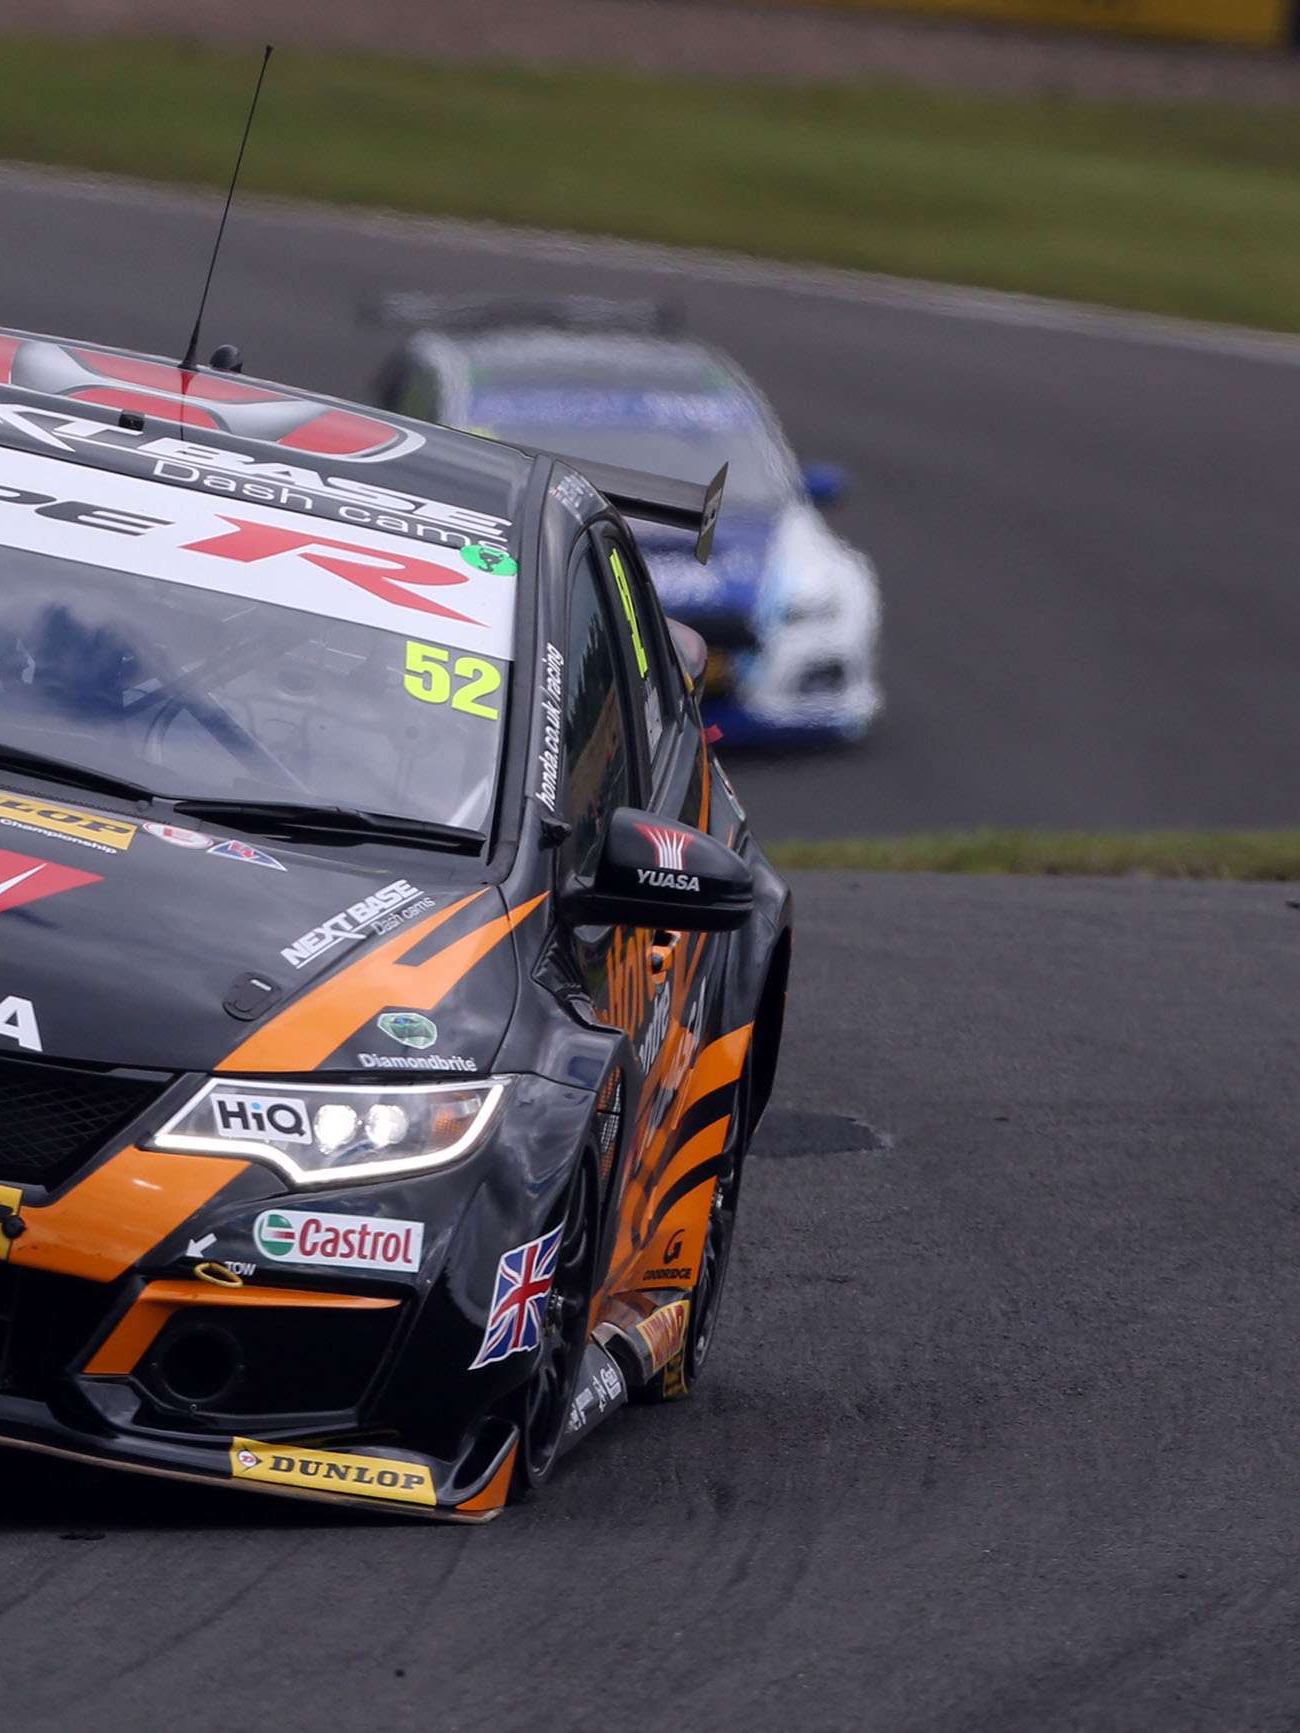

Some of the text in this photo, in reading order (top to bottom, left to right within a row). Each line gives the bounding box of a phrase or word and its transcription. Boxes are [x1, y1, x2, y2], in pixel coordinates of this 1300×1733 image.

[153, 459, 509, 556] Dash cams
[177, 513, 490, 628] R
[403, 640, 502, 720] 52
[534, 640, 567, 812] honda.co.uk/racing
[0, 818, 118, 854] Championship
[636, 869, 700, 893] YUASA
[370, 897, 436, 936] Dash cams
[358, 1052, 475, 1073] Diamondbrite
[217, 1100, 308, 1139] HiQ
[298, 1217, 414, 1266] Castrol
[224, 1261, 257, 1277] TOW
[268, 1455, 425, 1490] DUNLOP
